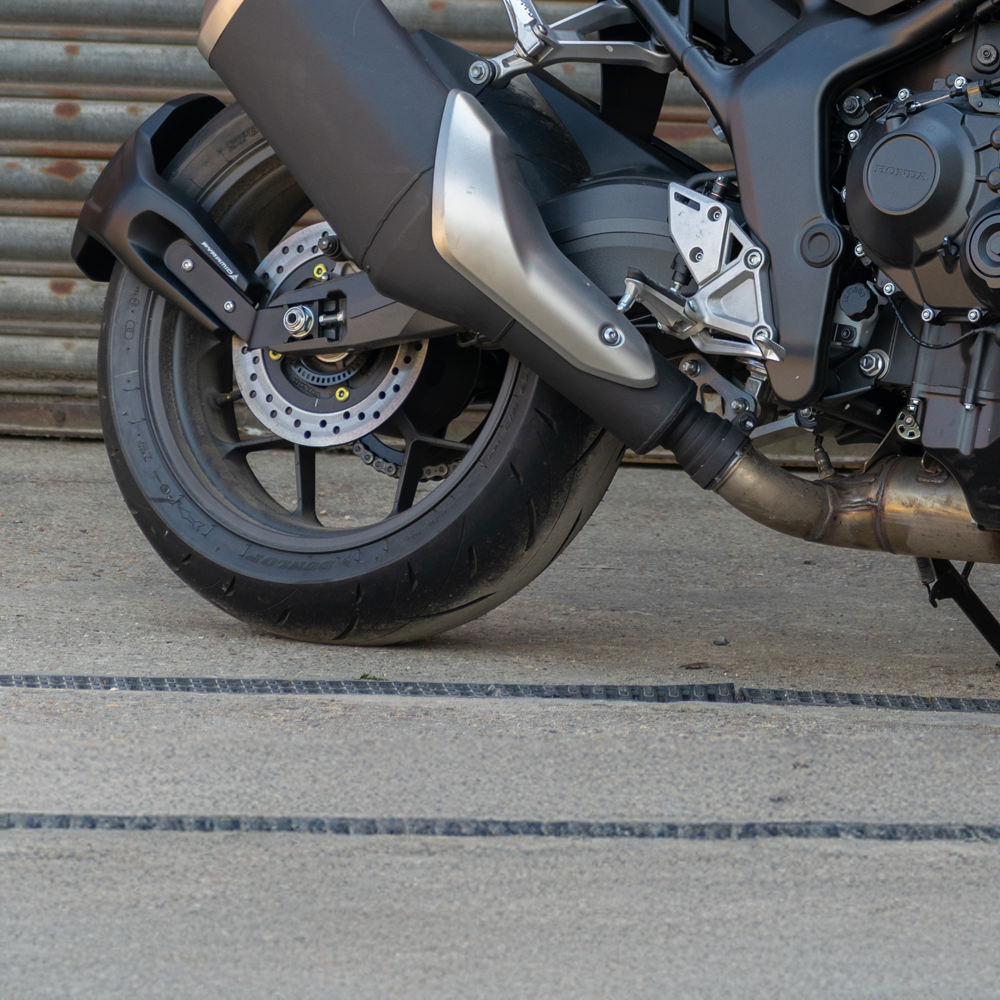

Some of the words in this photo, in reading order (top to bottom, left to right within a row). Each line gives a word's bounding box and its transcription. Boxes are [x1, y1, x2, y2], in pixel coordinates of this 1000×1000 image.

[873, 164, 928, 182] HONDA
[200, 241, 234, 275] PYRAMID
[243, 553, 337, 571] DUNLOP
